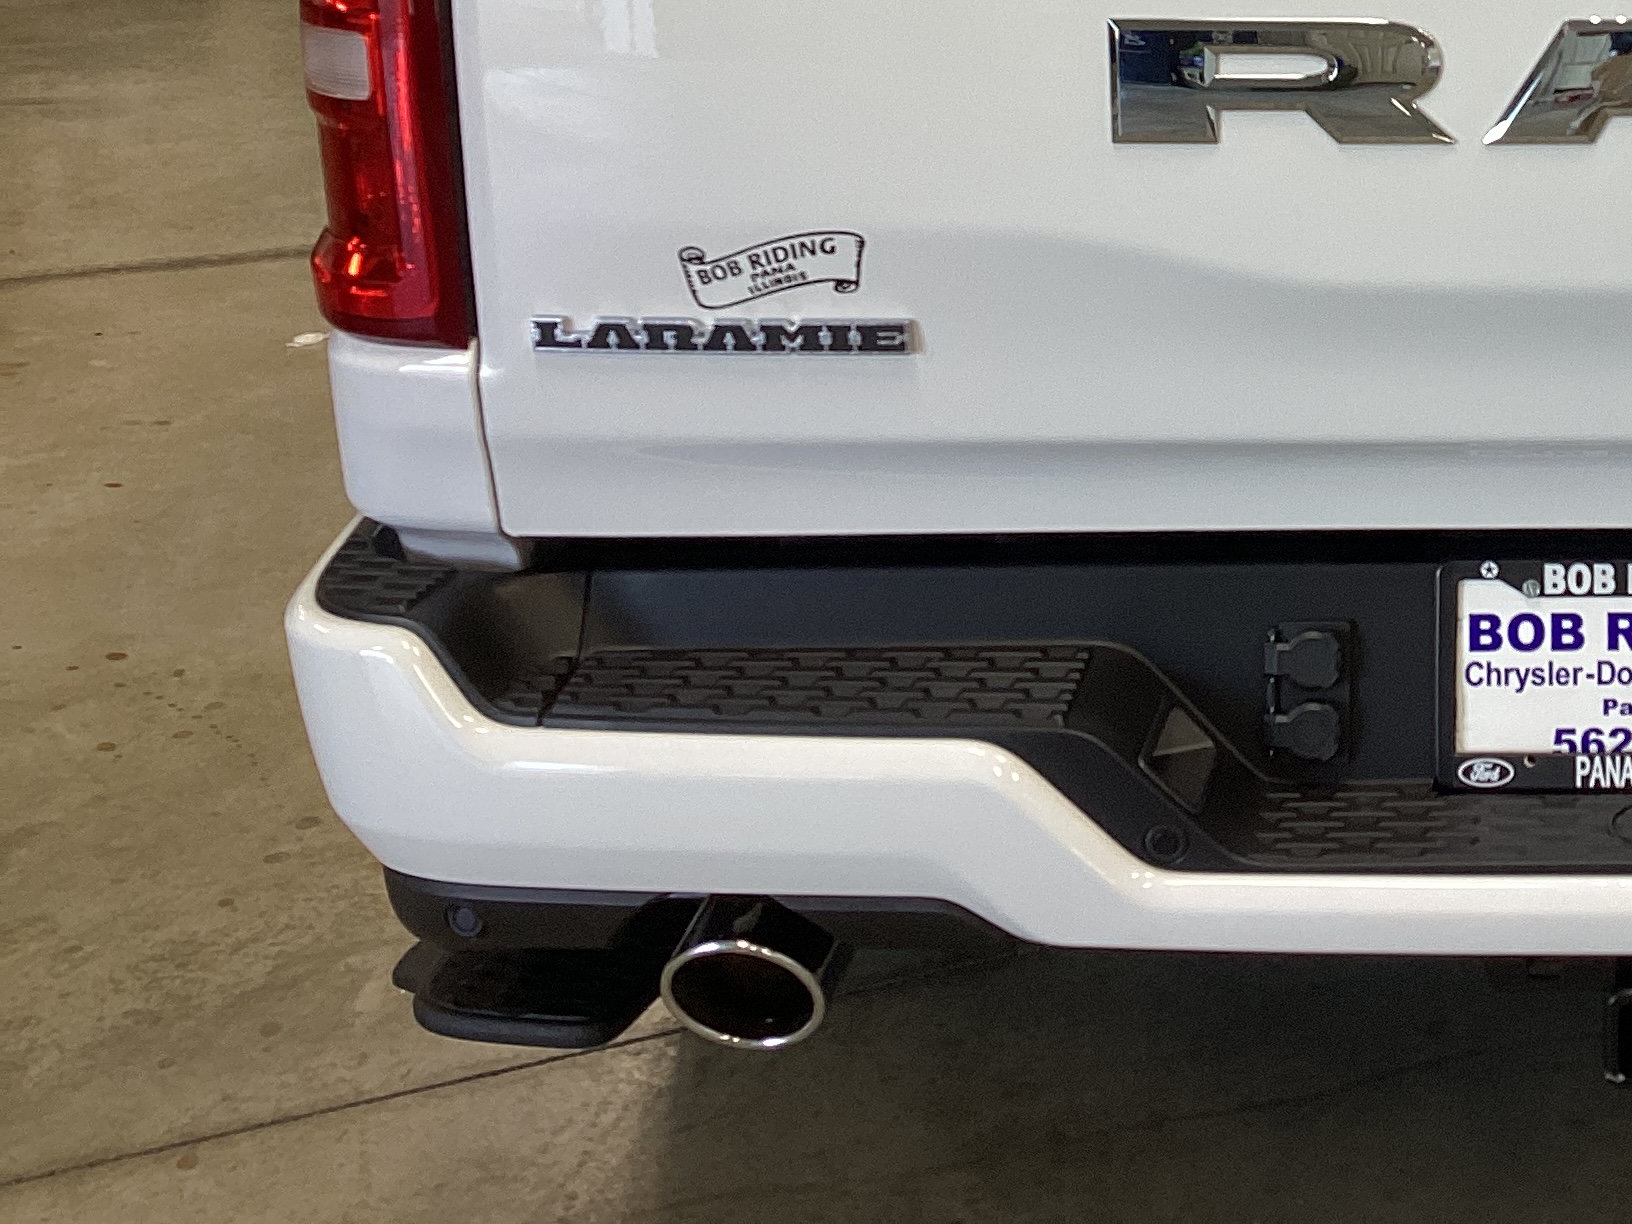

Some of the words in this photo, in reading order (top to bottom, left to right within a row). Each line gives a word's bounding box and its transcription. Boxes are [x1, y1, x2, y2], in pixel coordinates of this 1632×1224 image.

[695, 260, 742, 285] BOB
[747, 237, 836, 271] RIDING
[750, 263, 796, 282] PANA
[530, 314, 916, 355] LARAMIE
[1543, 563, 1617, 595] BOB
[1468, 613, 1585, 652] BOB
